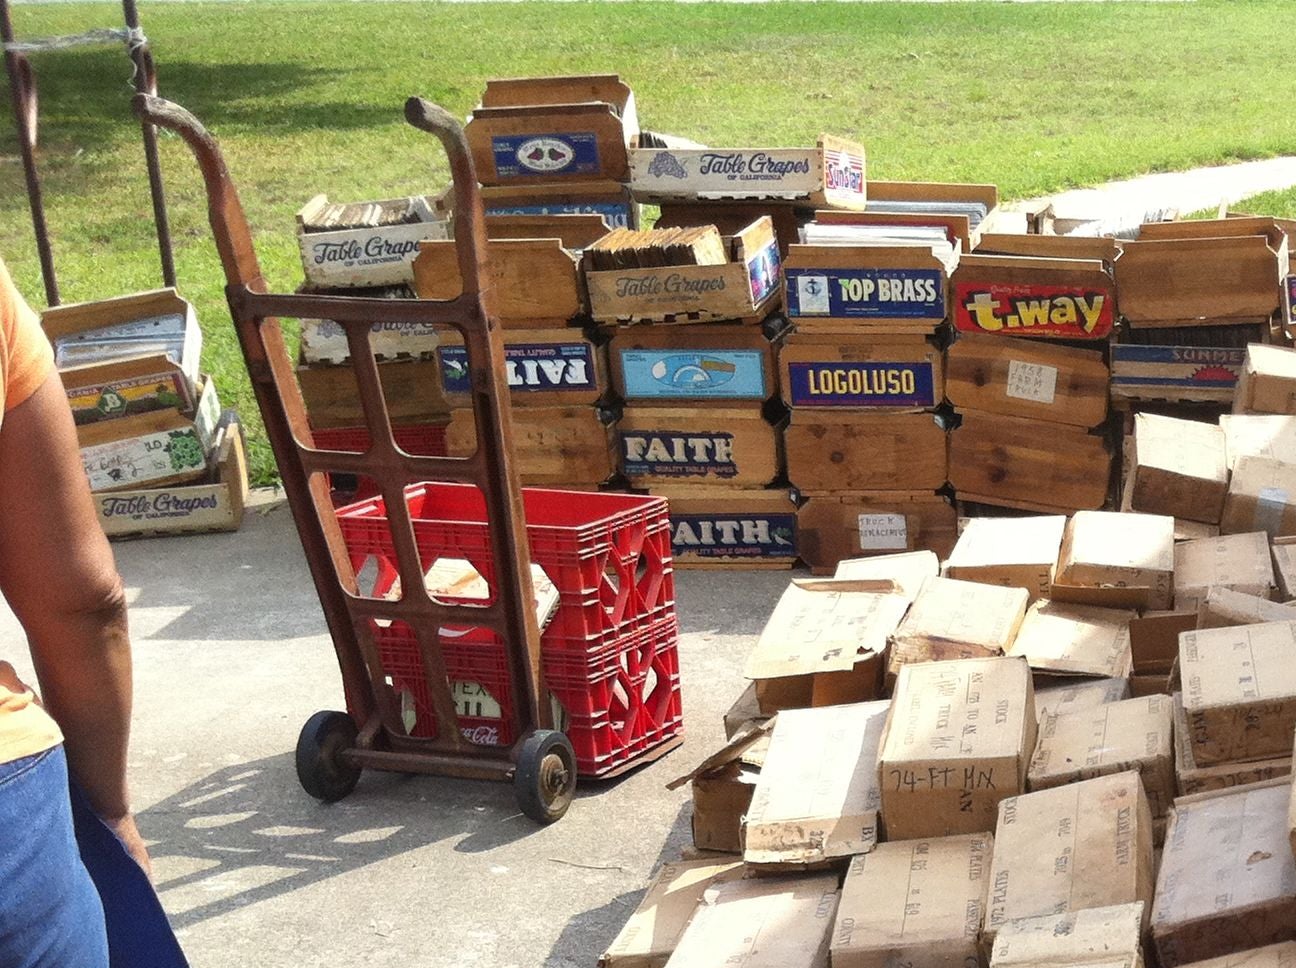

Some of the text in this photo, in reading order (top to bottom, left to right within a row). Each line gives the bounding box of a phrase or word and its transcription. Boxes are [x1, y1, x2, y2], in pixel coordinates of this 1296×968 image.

[700, 153, 810, 176] Table Grapes
[312, 240, 362, 264] Table
[616, 273, 726, 298] Table Grapes
[838, 278, 937, 303] TOP BRASS
[966, 293, 1104, 333] t.way
[808, 369, 915, 395] LOGOLUSO
[103, 492, 218, 518] Table Grapes
[671, 520, 772, 545] AITH
